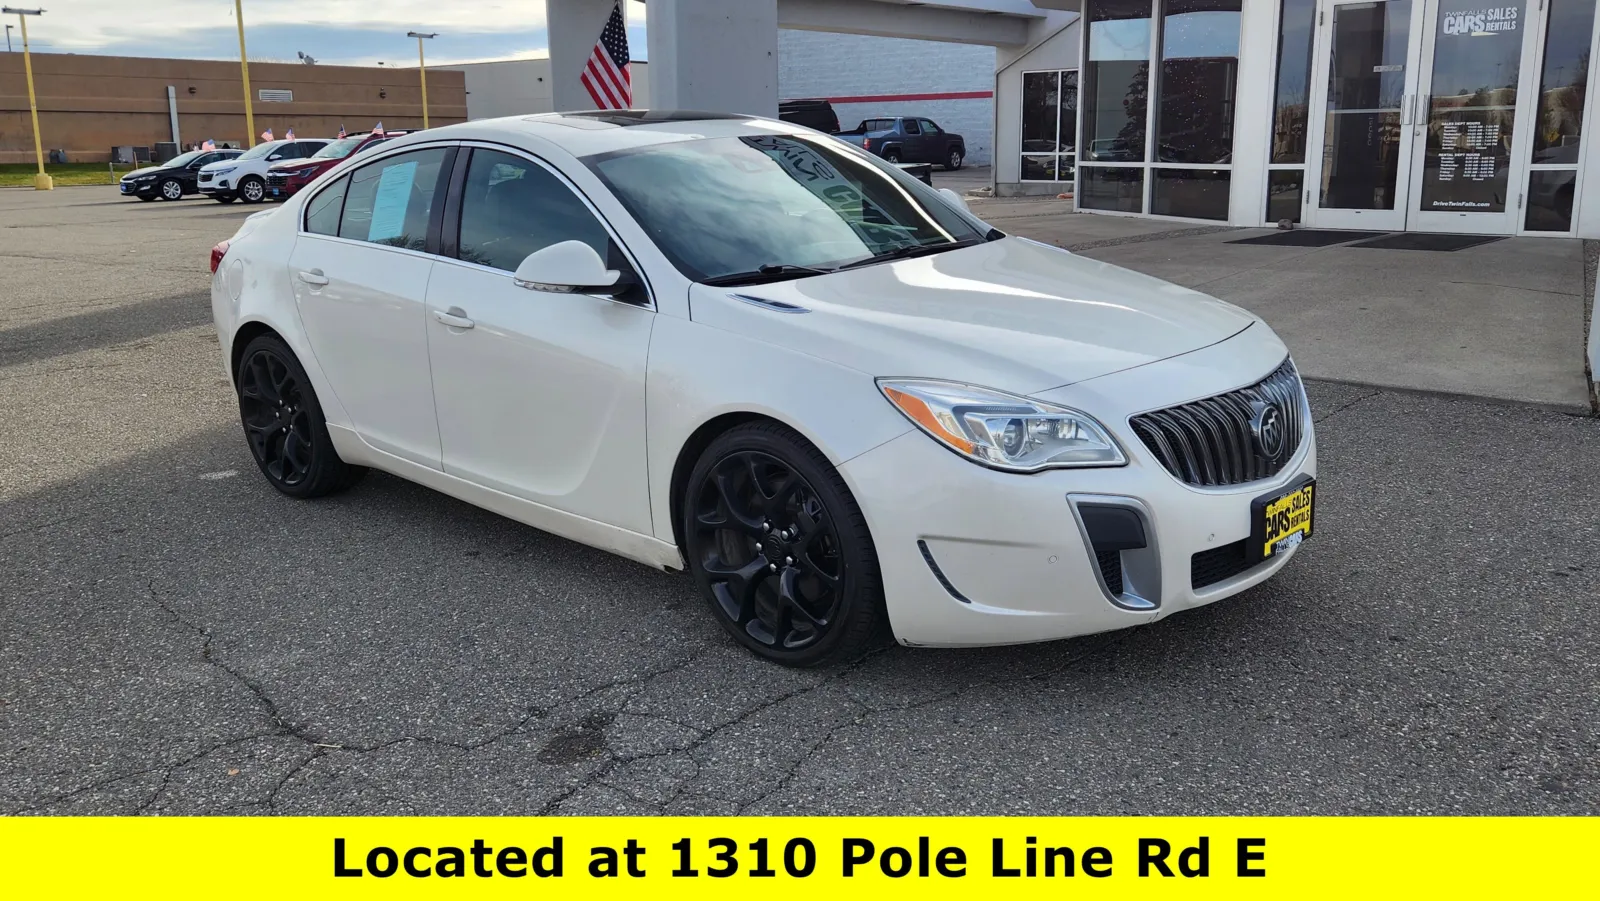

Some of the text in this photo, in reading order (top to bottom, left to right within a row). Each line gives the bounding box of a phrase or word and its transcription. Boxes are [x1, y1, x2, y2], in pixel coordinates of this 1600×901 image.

[1487, 7, 1518, 21] SALES
[1443, 14, 1486, 35] CARS
[1486, 21, 1517, 32] RENTALS
[1292, 490, 1311, 513] SALES
[1266, 507, 1290, 542] CARS
[1291, 510, 1310, 529] RENTALS
